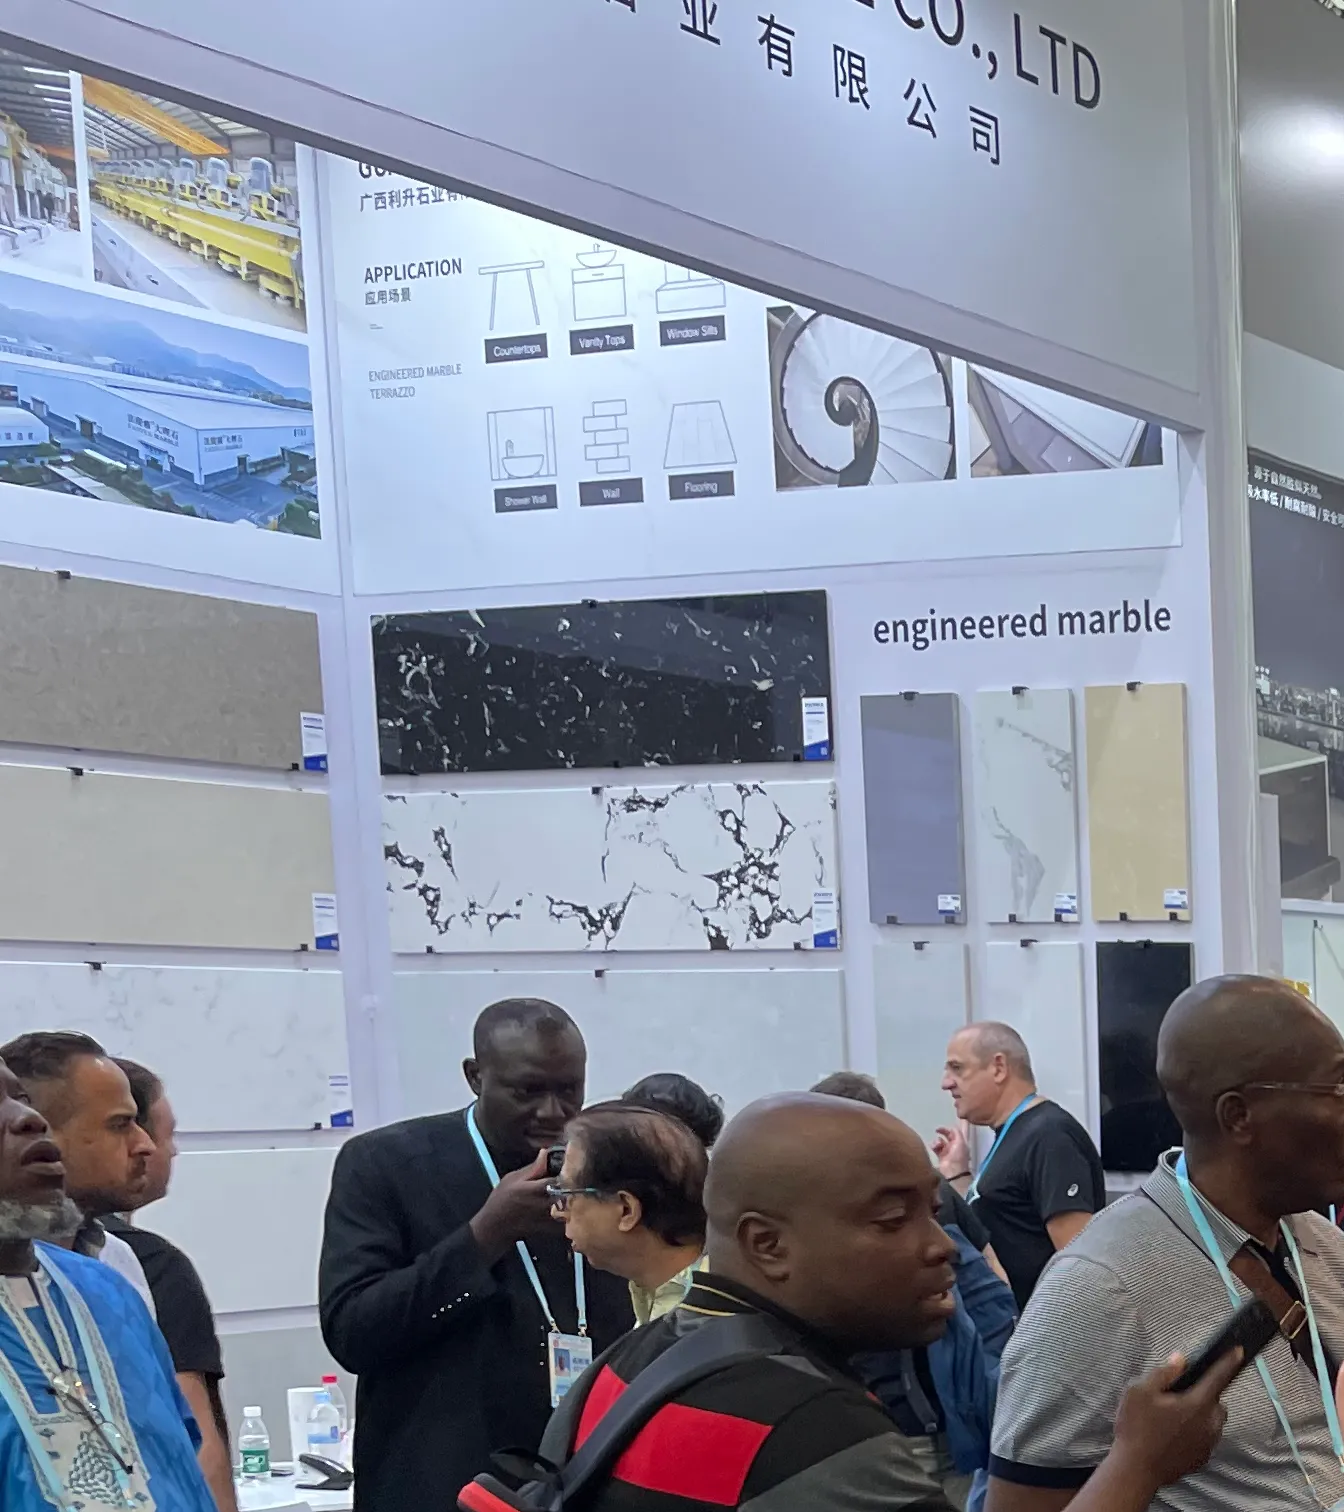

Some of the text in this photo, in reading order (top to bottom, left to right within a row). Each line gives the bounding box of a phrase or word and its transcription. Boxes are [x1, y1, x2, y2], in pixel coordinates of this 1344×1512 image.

[364, 258, 462, 284] APPLICATION
[365, 287, 411, 305] 应用场景
[666, 328, 699, 340] Window
[579, 334, 626, 349] Vanity Tops
[493, 344, 542, 358] Countertops
[369, 363, 462, 382] ENGINEERED MARBLE
[370, 386, 416, 400] TERRAZZO
[602, 487, 621, 499] Wall
[684, 481, 718, 494] Flooring
[873, 598, 1172, 652] engineered marble
